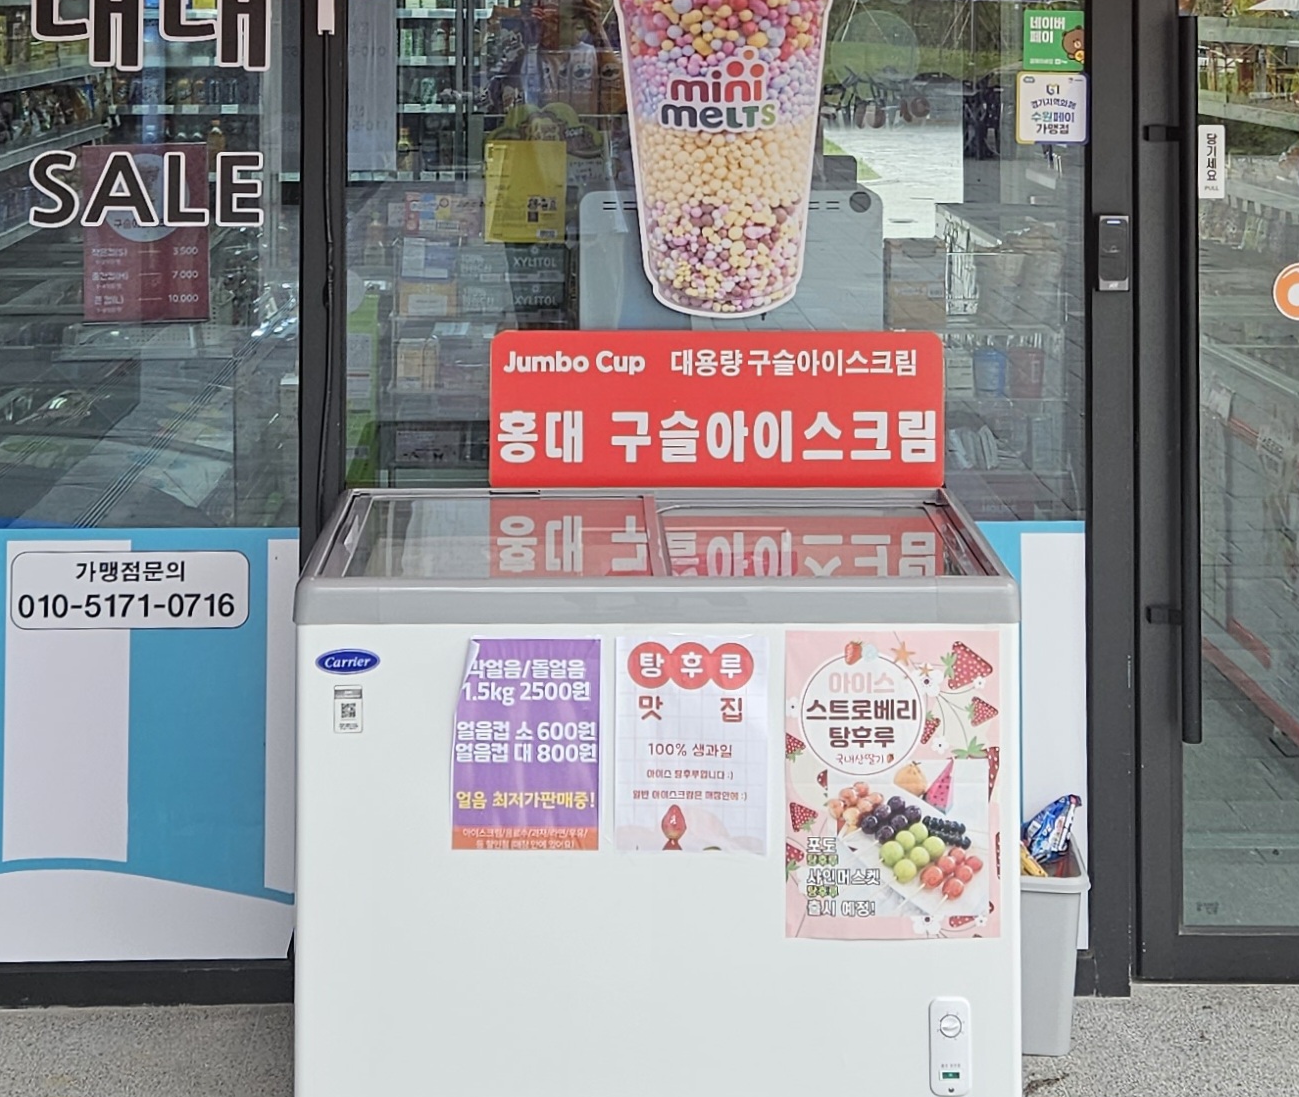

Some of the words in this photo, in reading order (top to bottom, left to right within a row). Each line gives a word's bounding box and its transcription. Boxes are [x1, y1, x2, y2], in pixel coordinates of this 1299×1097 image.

[1029, 16, 1066, 30] 네이버
[1029, 30, 1054, 43] 페이
[670, 59, 763, 103] mini
[1030, 111, 1075, 123] 수원페이
[1036, 123, 1070, 135] 가맹점
[1206, 132, 1218, 182] 당기세요
[28, 150, 265, 228] SALE
[513, 256, 557, 269] XYLITOL
[514, 295, 557, 307] XYLITOL
[503, 349, 590, 374] Jumbo
[595, 350, 646, 376] Cup
[670, 349, 742, 377] 대용량
[747, 349, 918, 377] 구슬아이스크림
[497, 410, 584, 464] 홍대
[610, 410, 937, 464] 구슬아이스크림
[75, 561, 187, 583] 가맹점문의
[18, 592, 236, 619] 010-5171-0716
[324, 656, 371, 669] Carrier
[638, 651, 744, 680] 탕후루
[828, 671, 896, 695] 아이스
[462, 681, 515, 707] 1.5kg
[519, 681, 591, 702] 2500원
[805, 698, 918, 721] 스트로베리
[456, 720, 510, 741] 얼음컵
[515, 720, 534, 741] 소
[536, 721, 597, 741] 600원
[829, 725, 896, 749] 탕후루
[455, 742, 509, 763] 얼음컵
[513, 742, 532, 763] 대
[536, 743, 598, 763] 800원
[647, 742, 687, 757] 100%
[692, 743, 733, 759] 생과일
[646, 769, 672, 779] 아이스
[456, 791, 488, 810] 얼음
[492, 790, 596, 810] 최저가판매중!
[652, 789, 703, 800] 아이스크림은
[807, 837, 837, 854] 포도
[841, 900, 876, 918] 예정!
